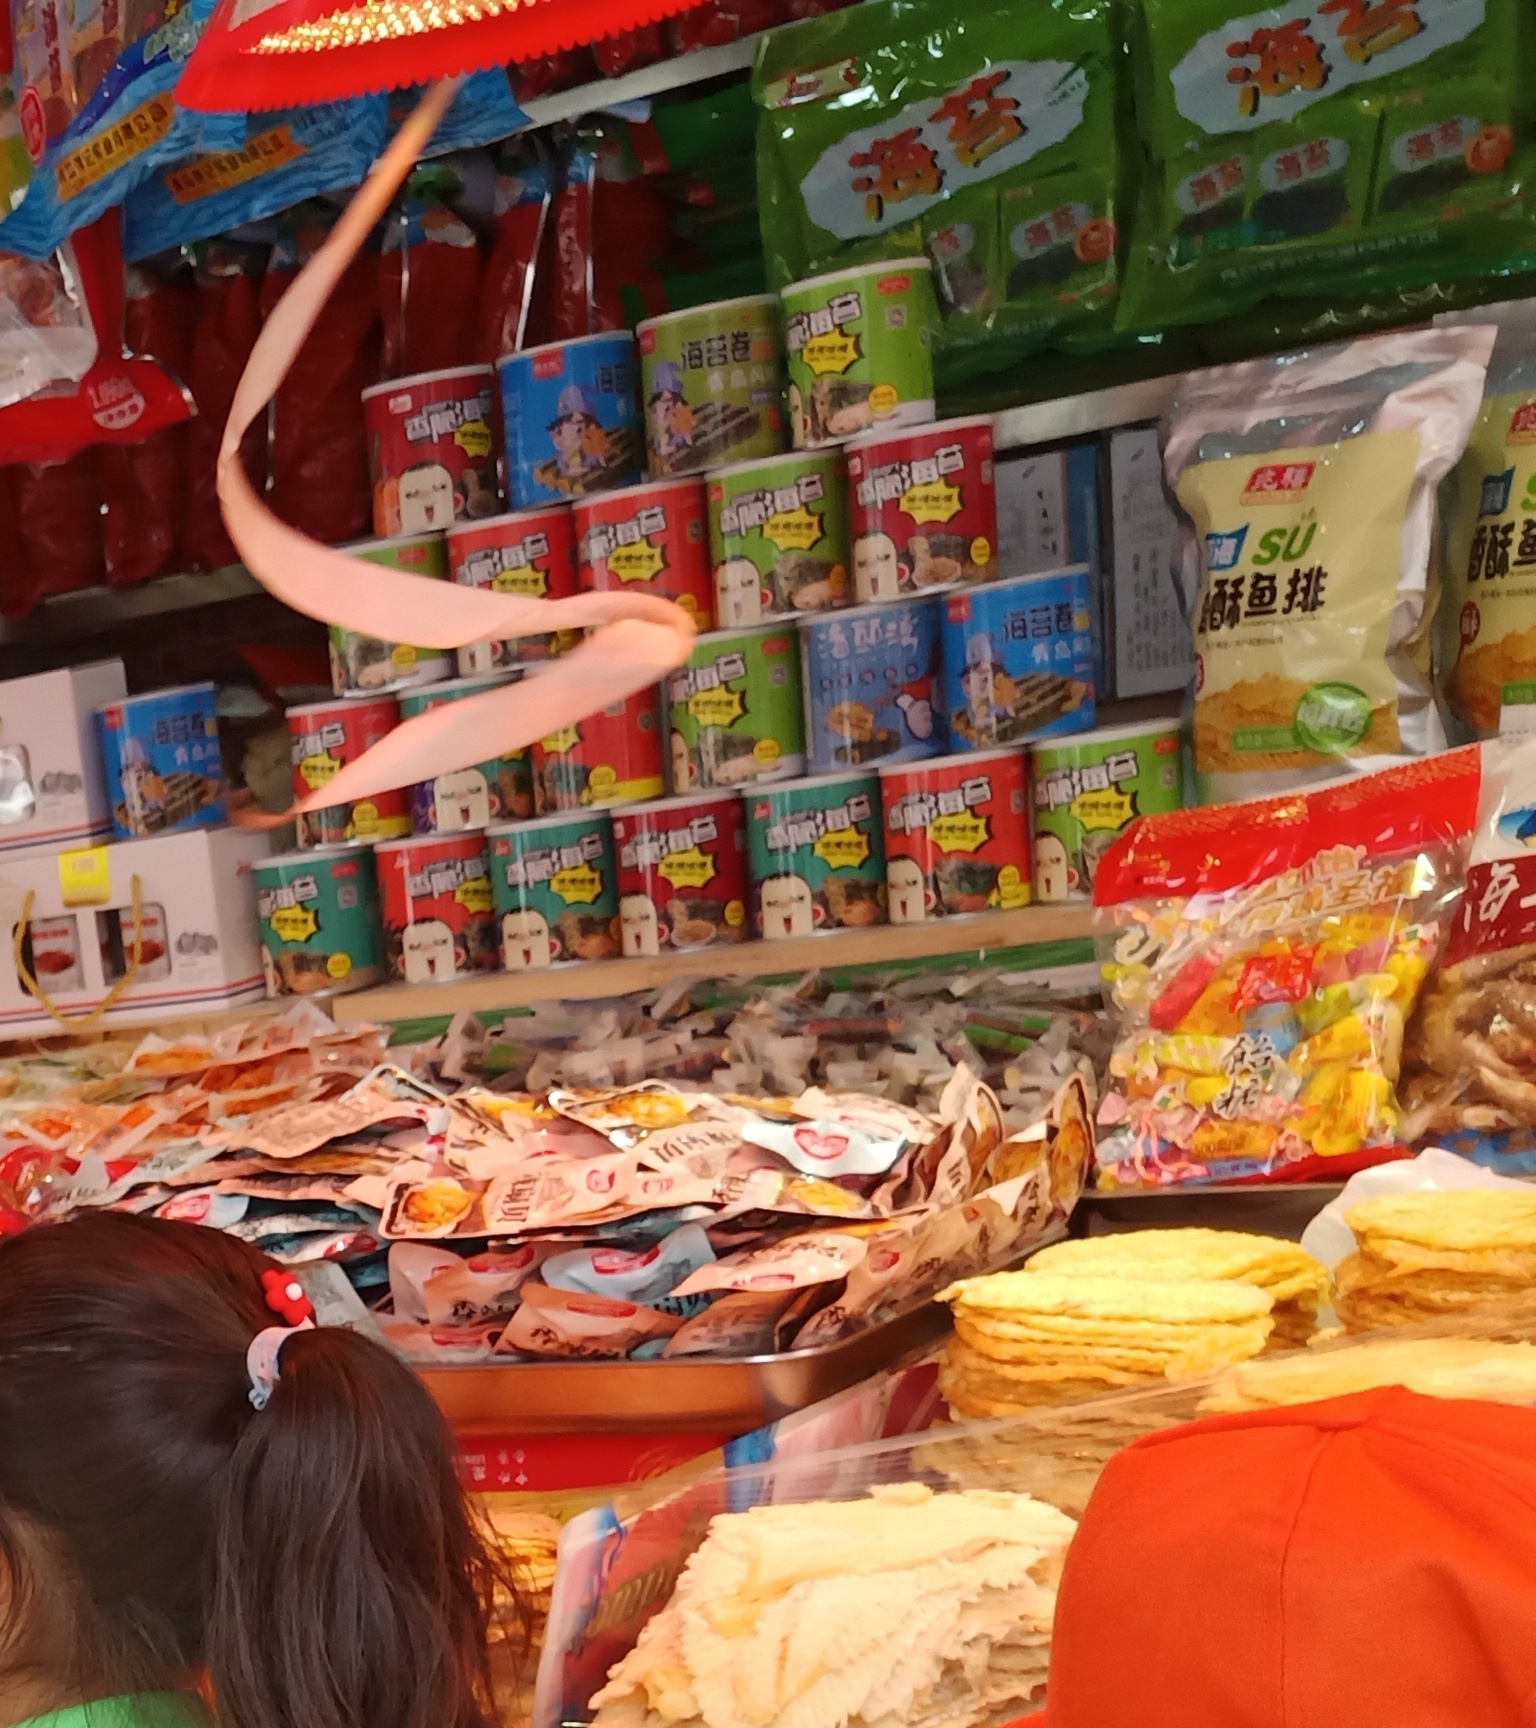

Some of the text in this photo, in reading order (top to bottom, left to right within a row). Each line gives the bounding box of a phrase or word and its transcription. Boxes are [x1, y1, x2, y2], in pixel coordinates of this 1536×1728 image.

[847, 68, 1030, 222] 海苔
[681, 329, 751, 371] 海苔卷
